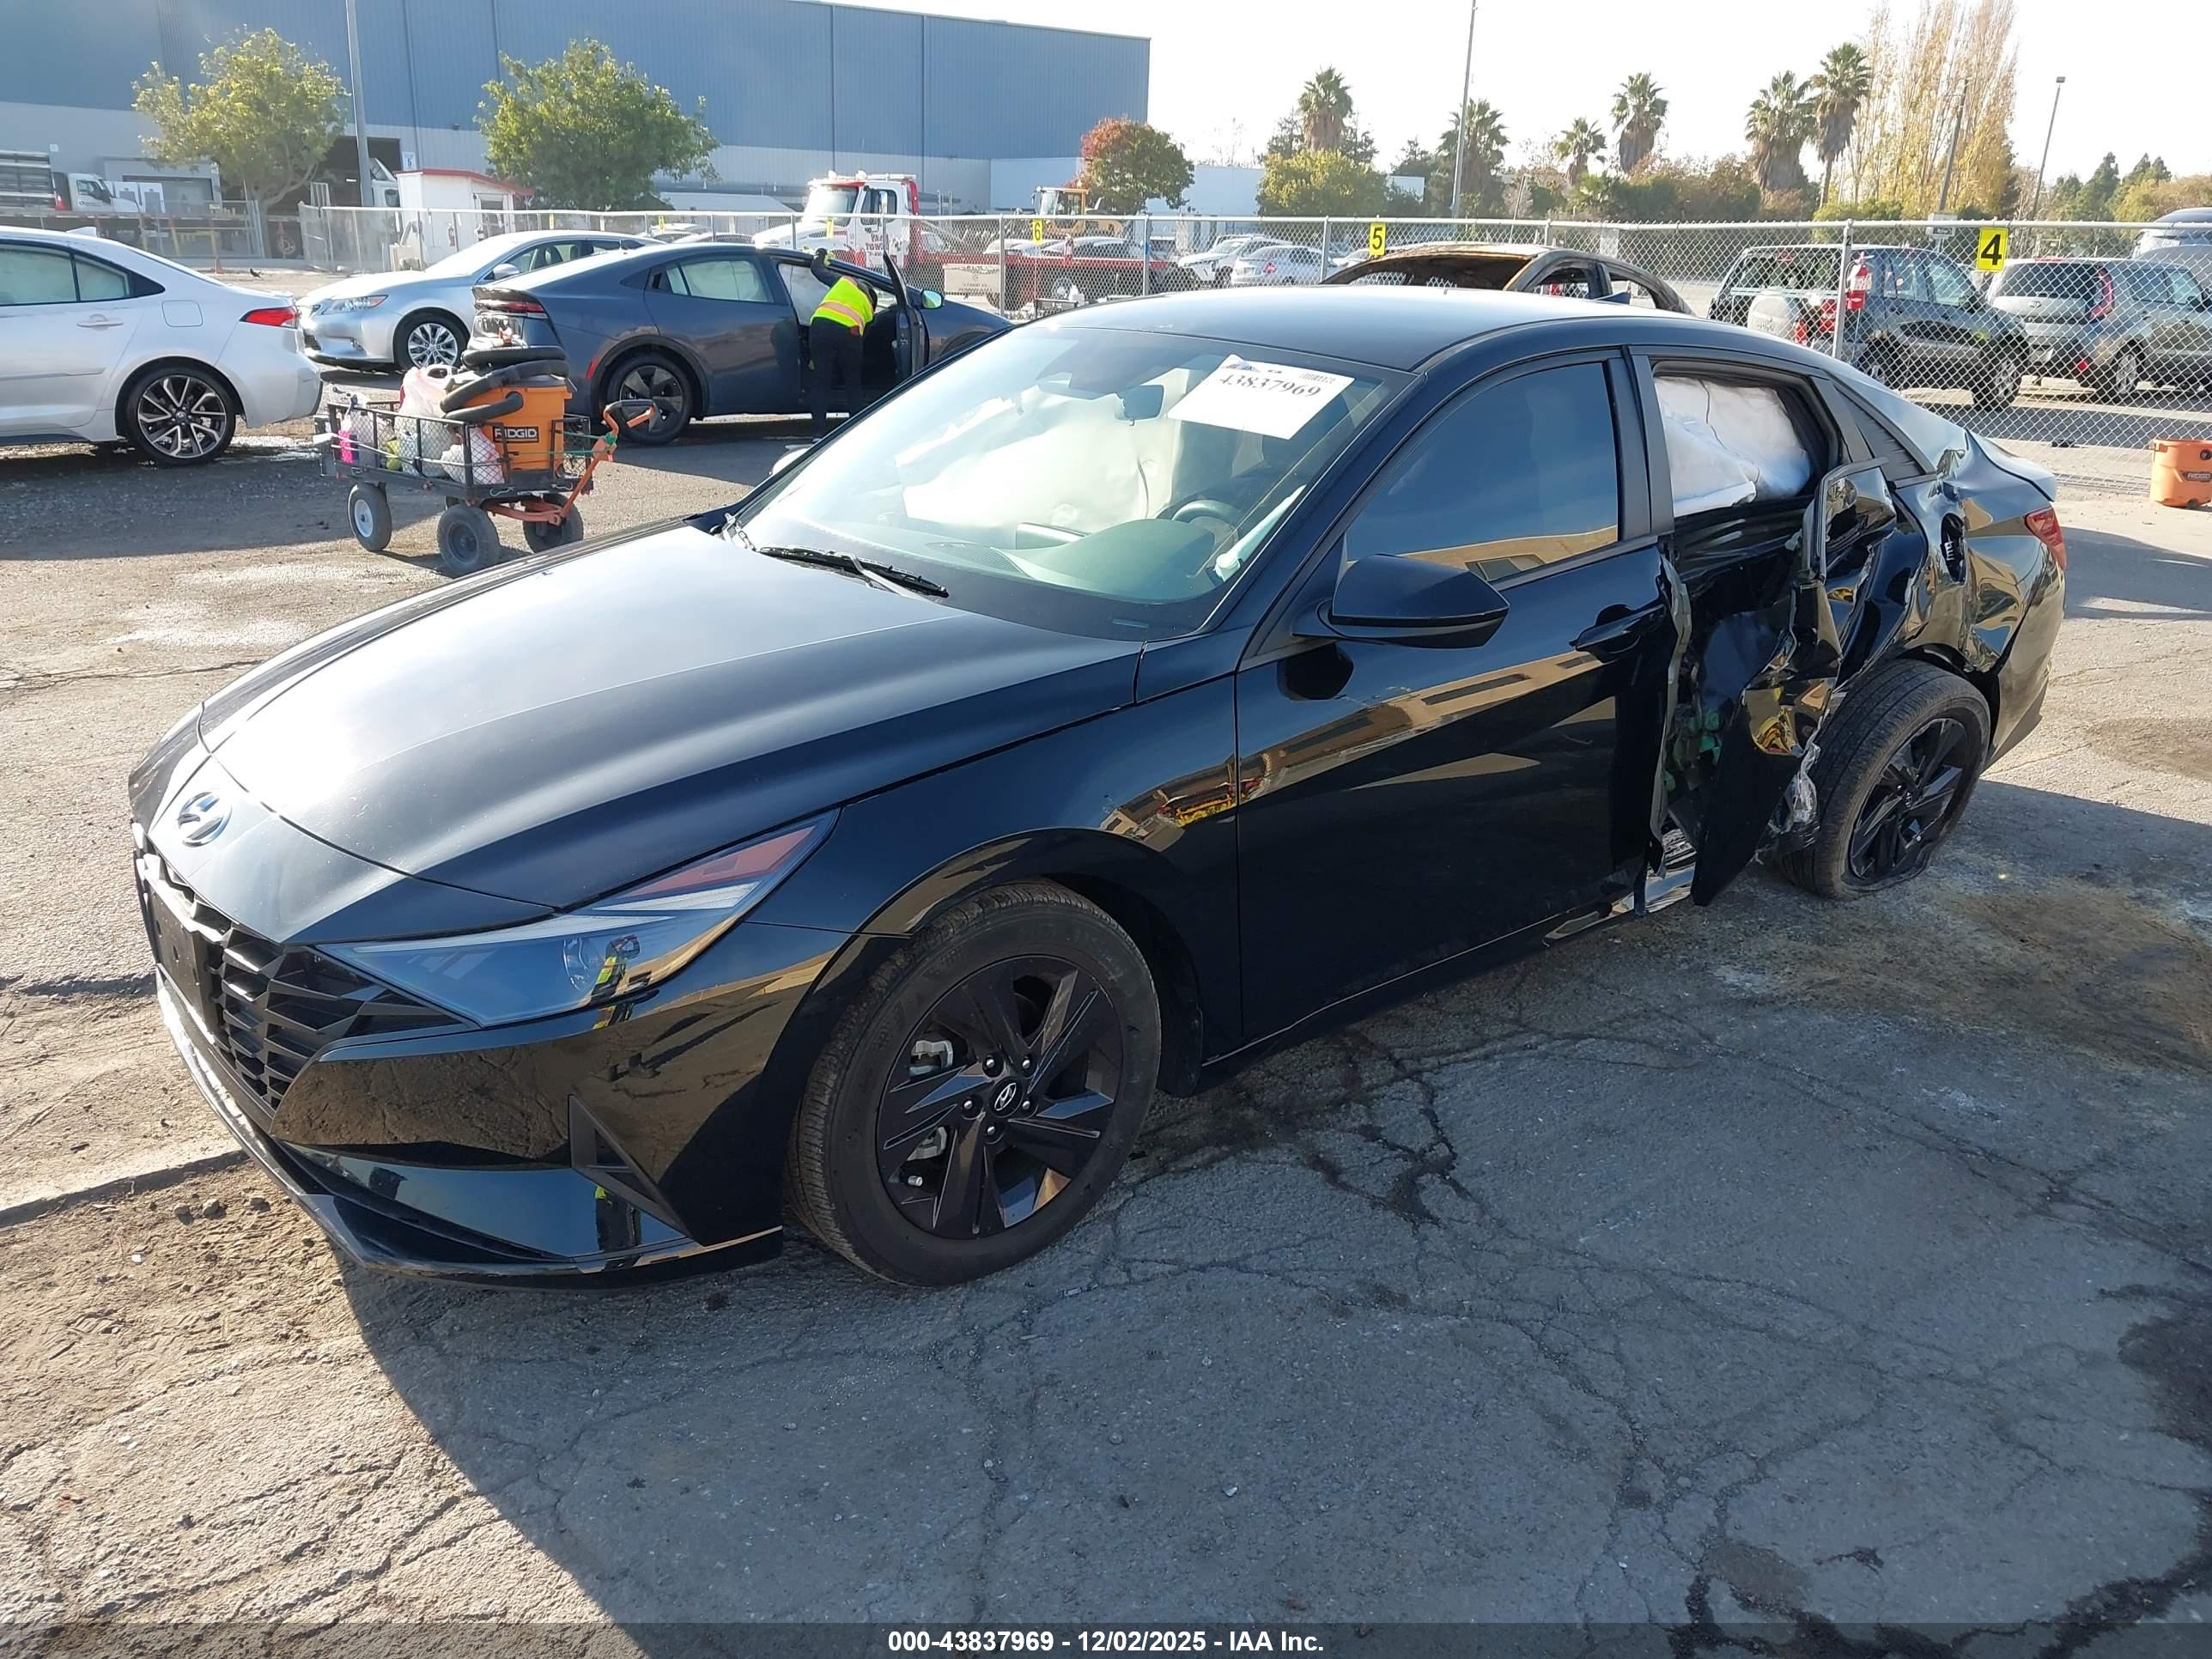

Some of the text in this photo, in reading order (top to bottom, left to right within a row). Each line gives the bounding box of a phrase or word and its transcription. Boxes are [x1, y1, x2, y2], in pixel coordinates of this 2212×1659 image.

[1035, 222, 1041, 241] 6
[1372, 227, 1382, 250] 5
[1981, 234, 2002, 265] 4
[1219, 374, 1322, 398] 43837969
